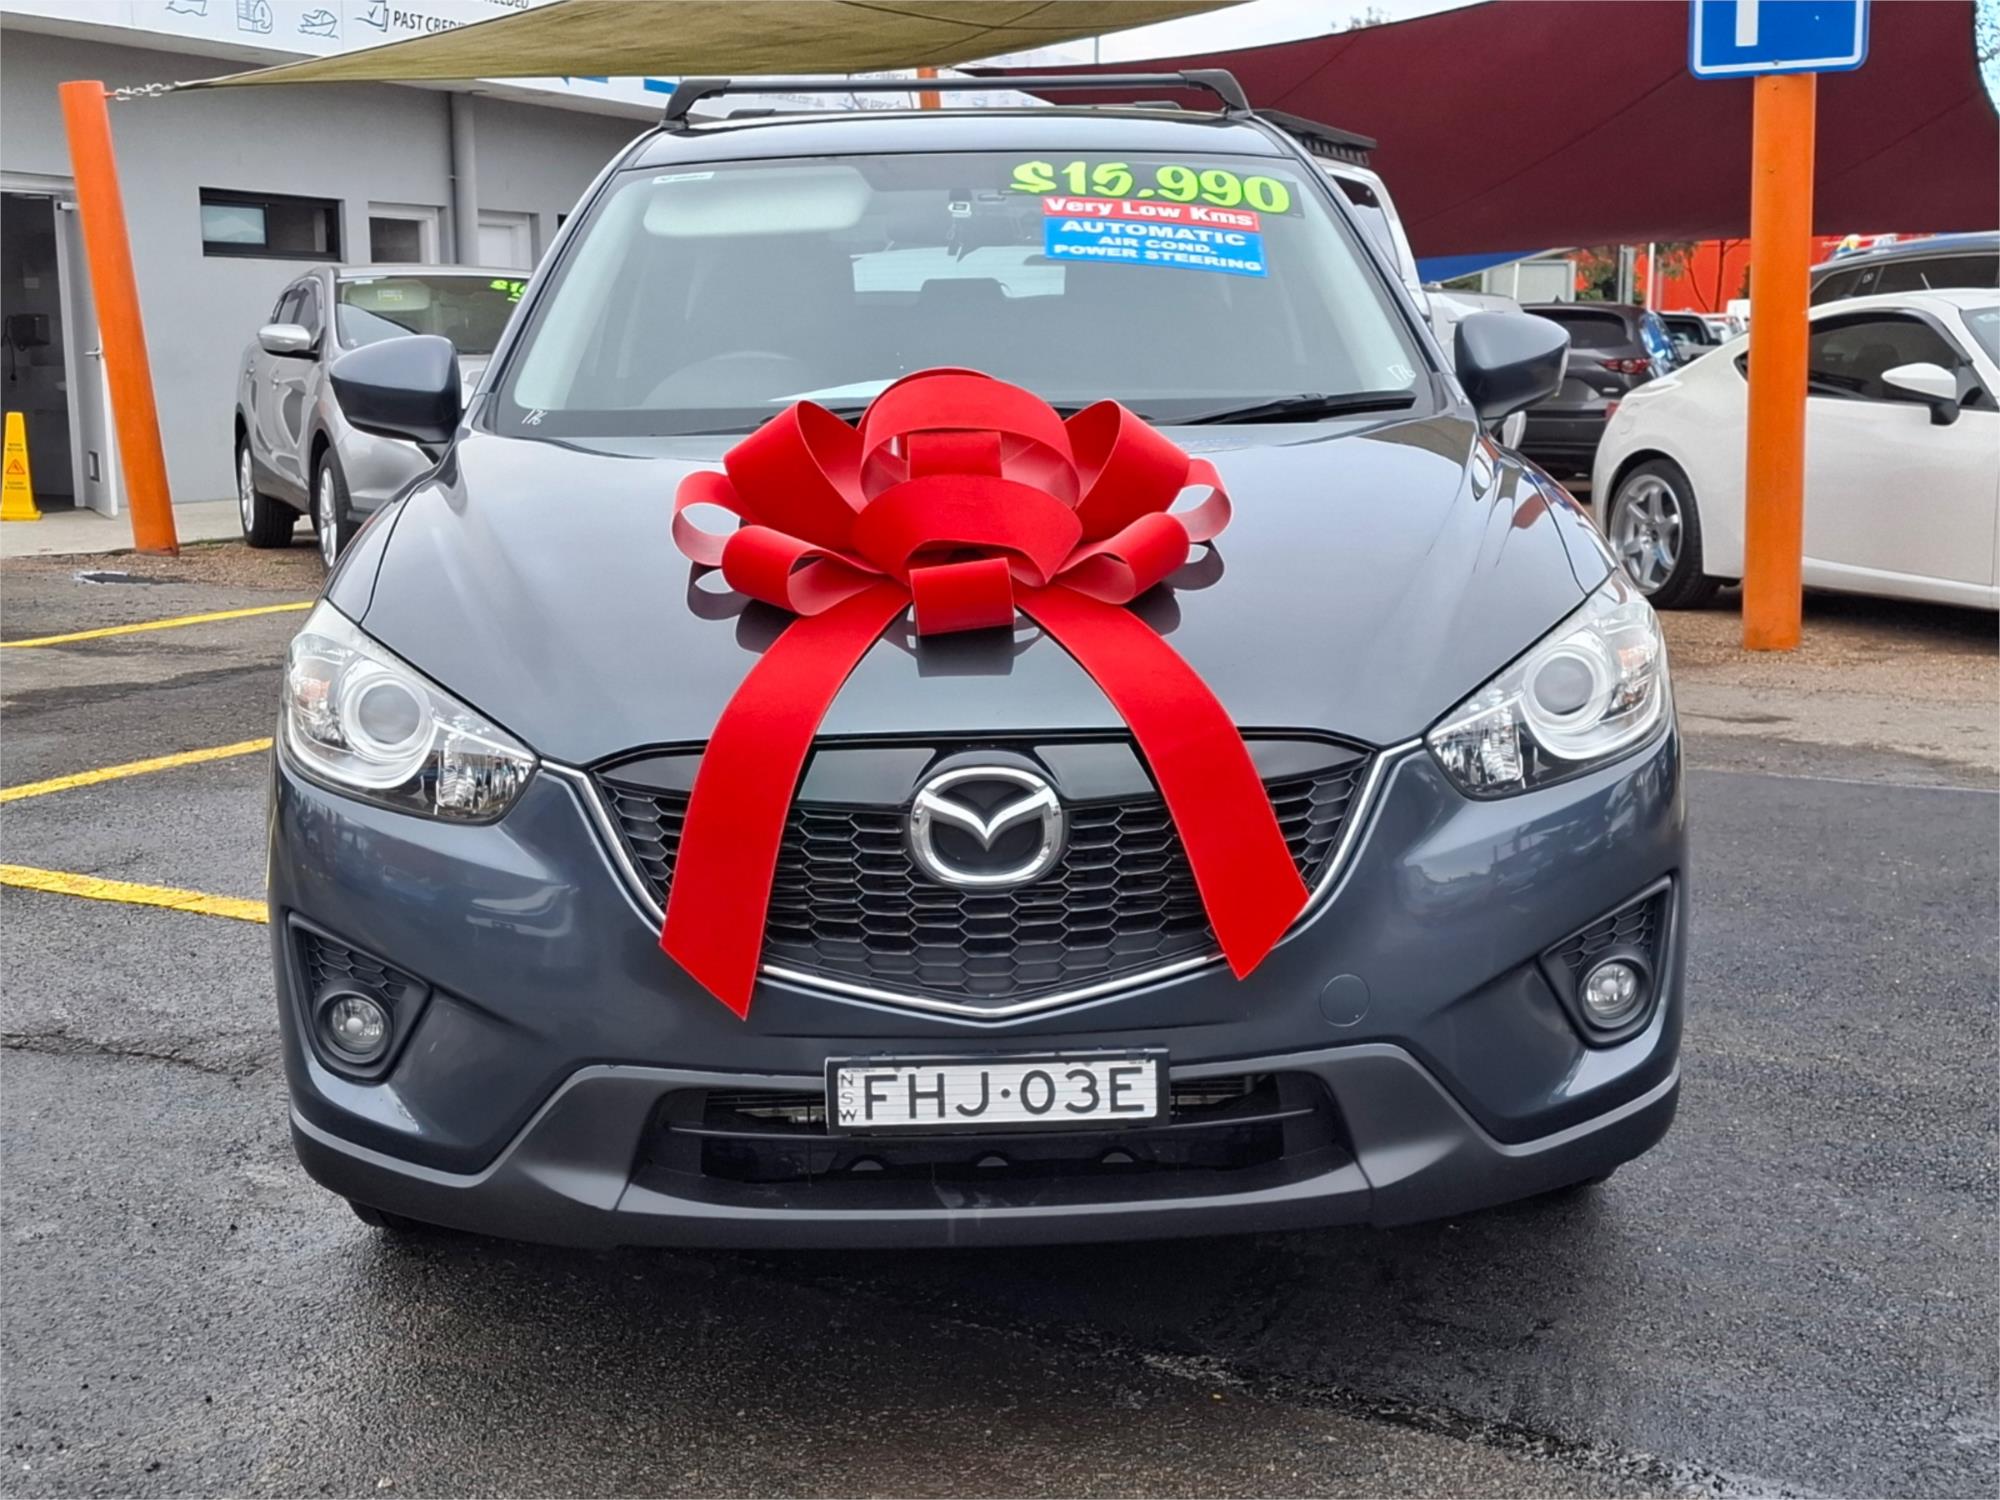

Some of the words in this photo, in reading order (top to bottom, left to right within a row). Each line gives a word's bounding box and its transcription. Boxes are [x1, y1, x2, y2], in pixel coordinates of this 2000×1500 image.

[393, 10, 424, 30] PAST
[426, 16, 467, 32] CRE
[1044, 197, 1114, 216] Very
[1123, 200, 1181, 218] Low
[1190, 206, 1255, 227] Kms
[1060, 219, 1248, 246] AUTOMATIC
[1097, 235, 1140, 248] AIR
[1145, 240, 1219, 255] COND.
[1053, 243, 1140, 258] POWER
[1145, 250, 1263, 272] STEERING
[840, 1073, 858, 1123] NSW
